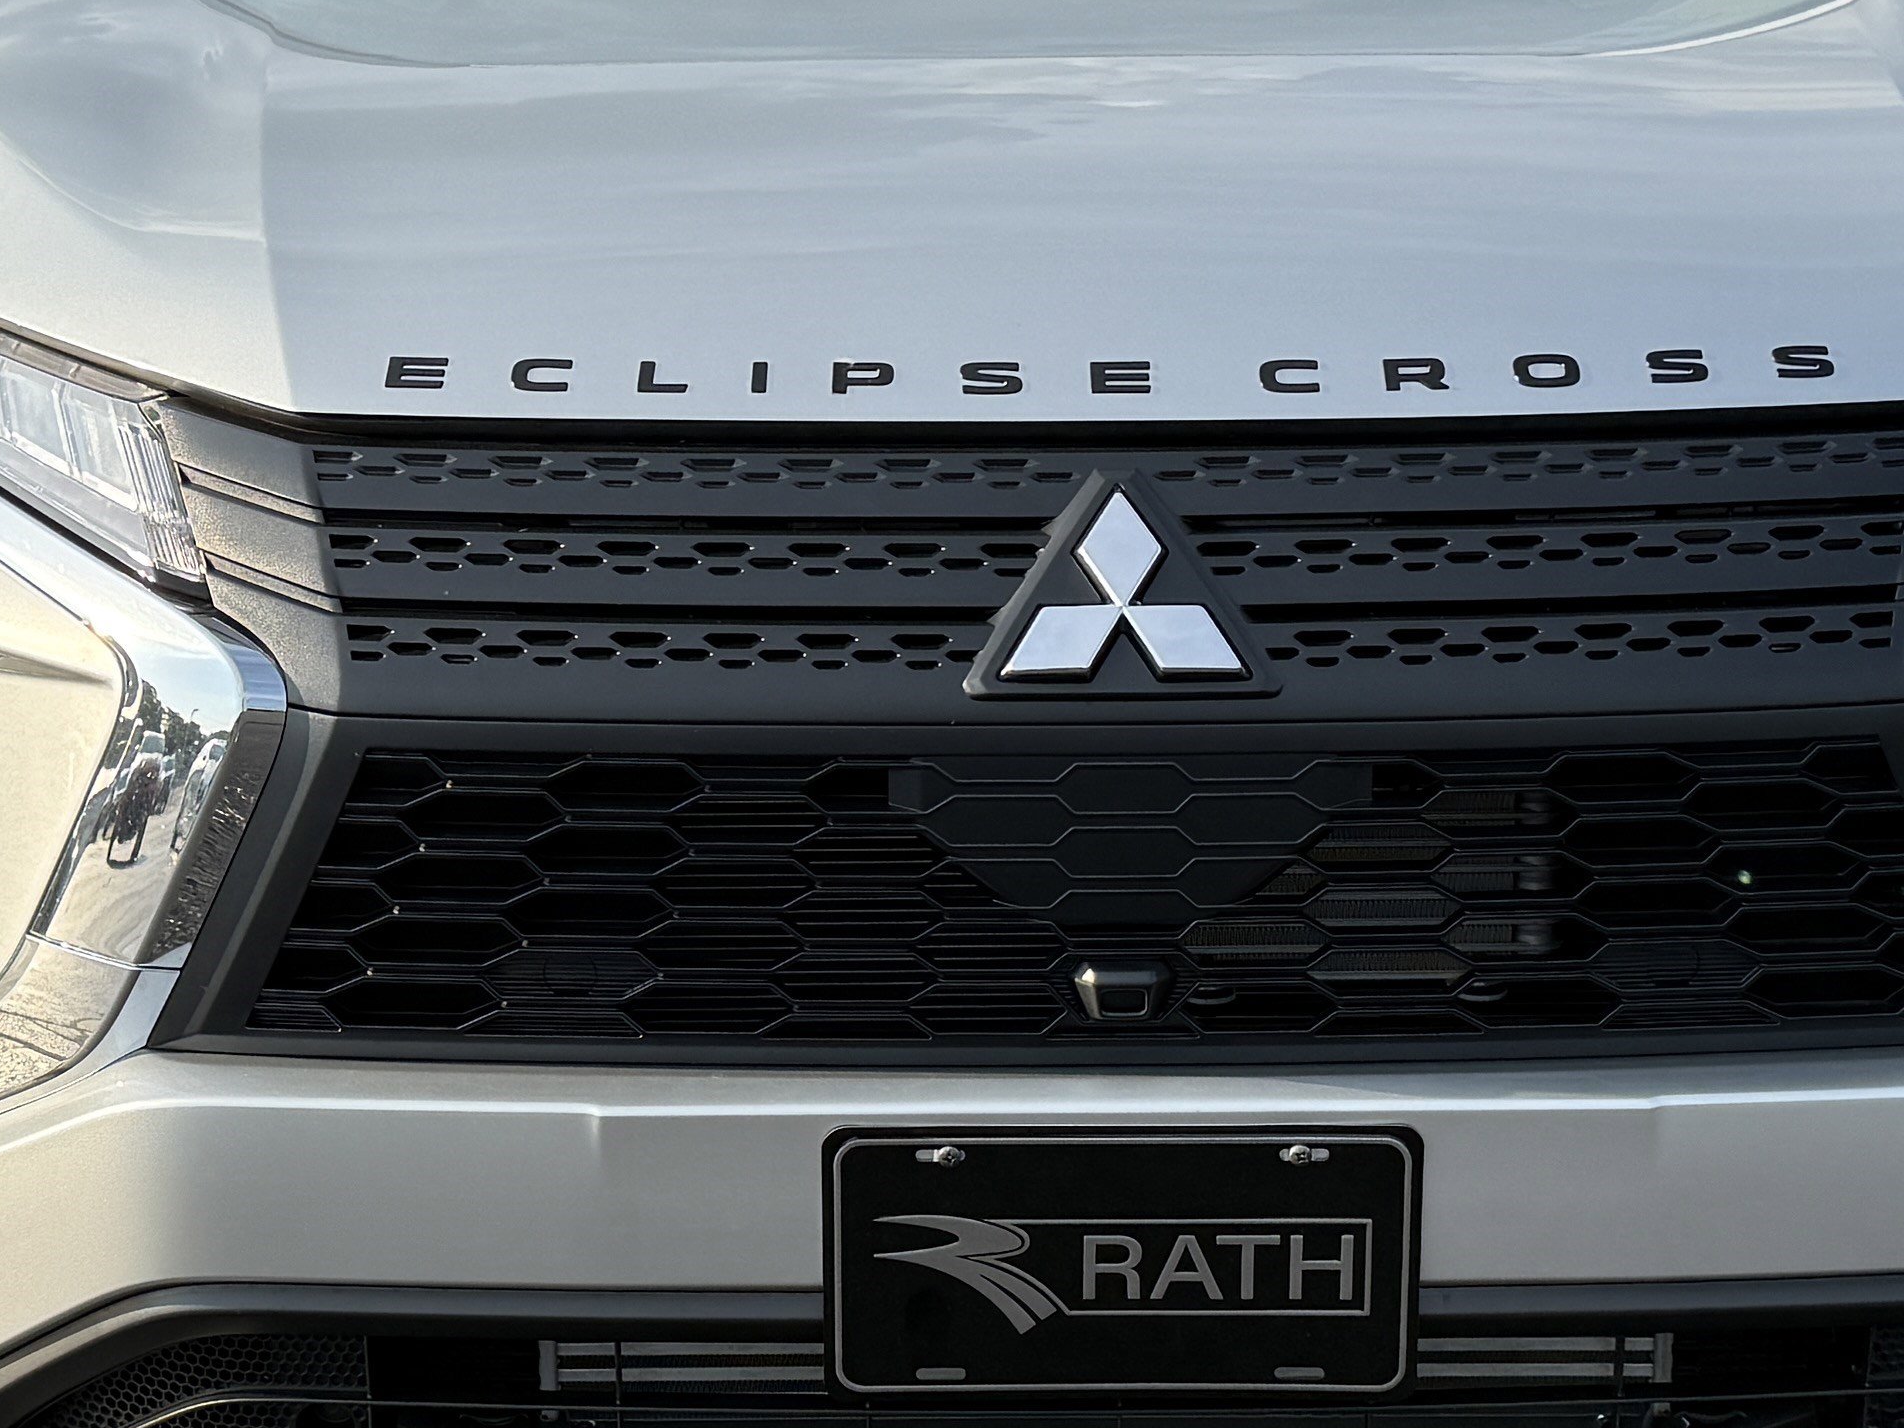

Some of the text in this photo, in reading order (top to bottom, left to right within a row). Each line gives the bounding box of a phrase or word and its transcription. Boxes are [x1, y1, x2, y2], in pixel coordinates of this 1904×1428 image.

[384, 345, 1835, 395] ECLIPSE CROSS
[1082, 1234, 1355, 1301] RATH
